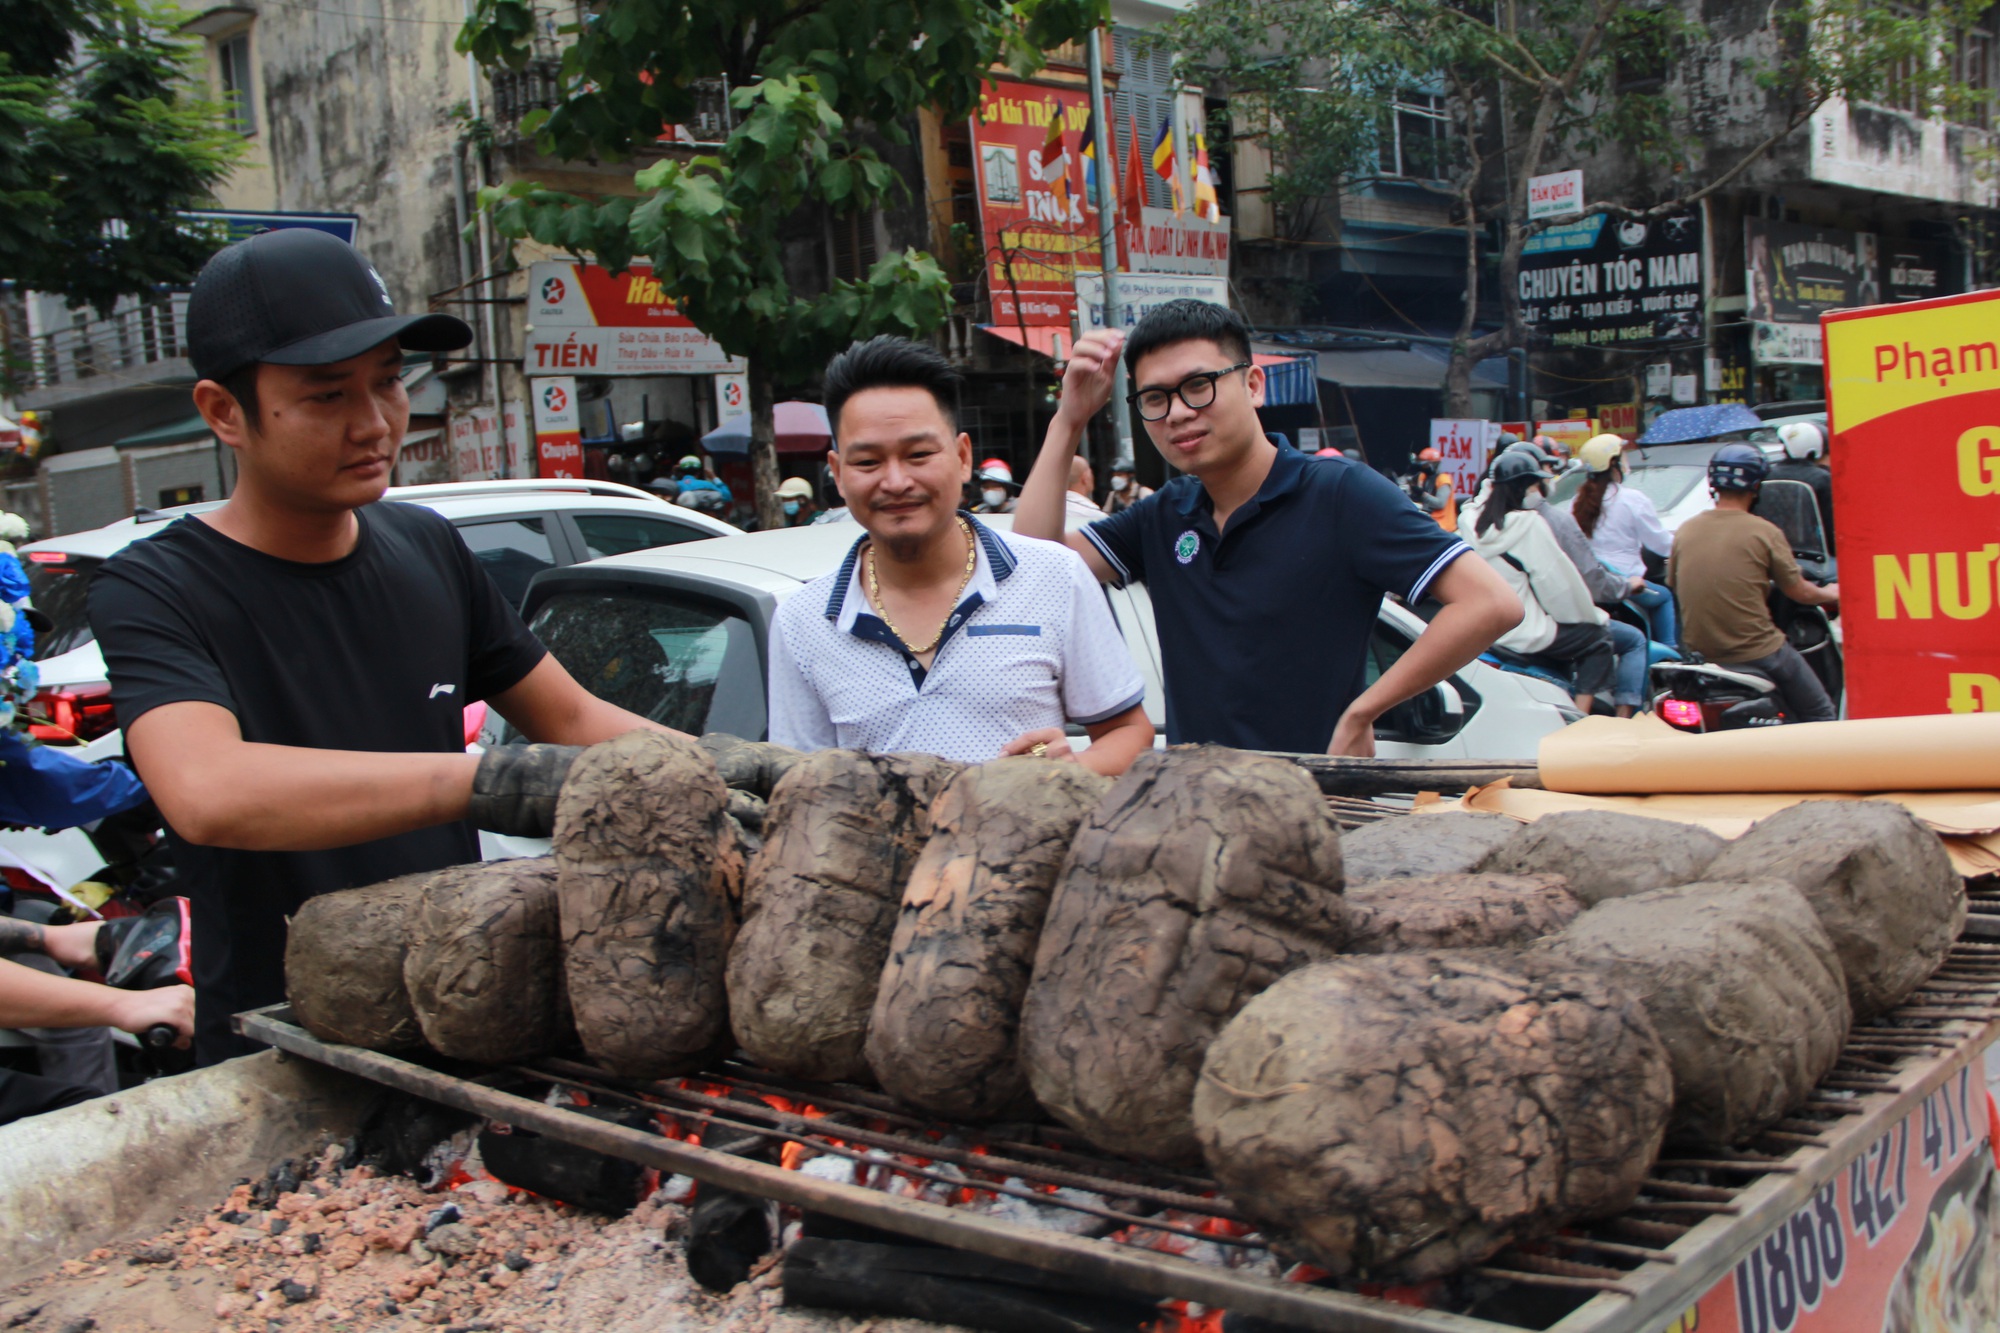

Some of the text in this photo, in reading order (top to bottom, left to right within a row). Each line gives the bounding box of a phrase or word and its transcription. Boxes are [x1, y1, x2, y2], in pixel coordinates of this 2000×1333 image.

[1519, 253, 1699, 300] CHUYÊN TÓC NAM
[1580, 302, 1604, 320] TẠO
[534, 332, 598, 368] TIẾN
[1875, 341, 2000, 387] Phạm
[1438, 423, 1472, 460] TẨM
